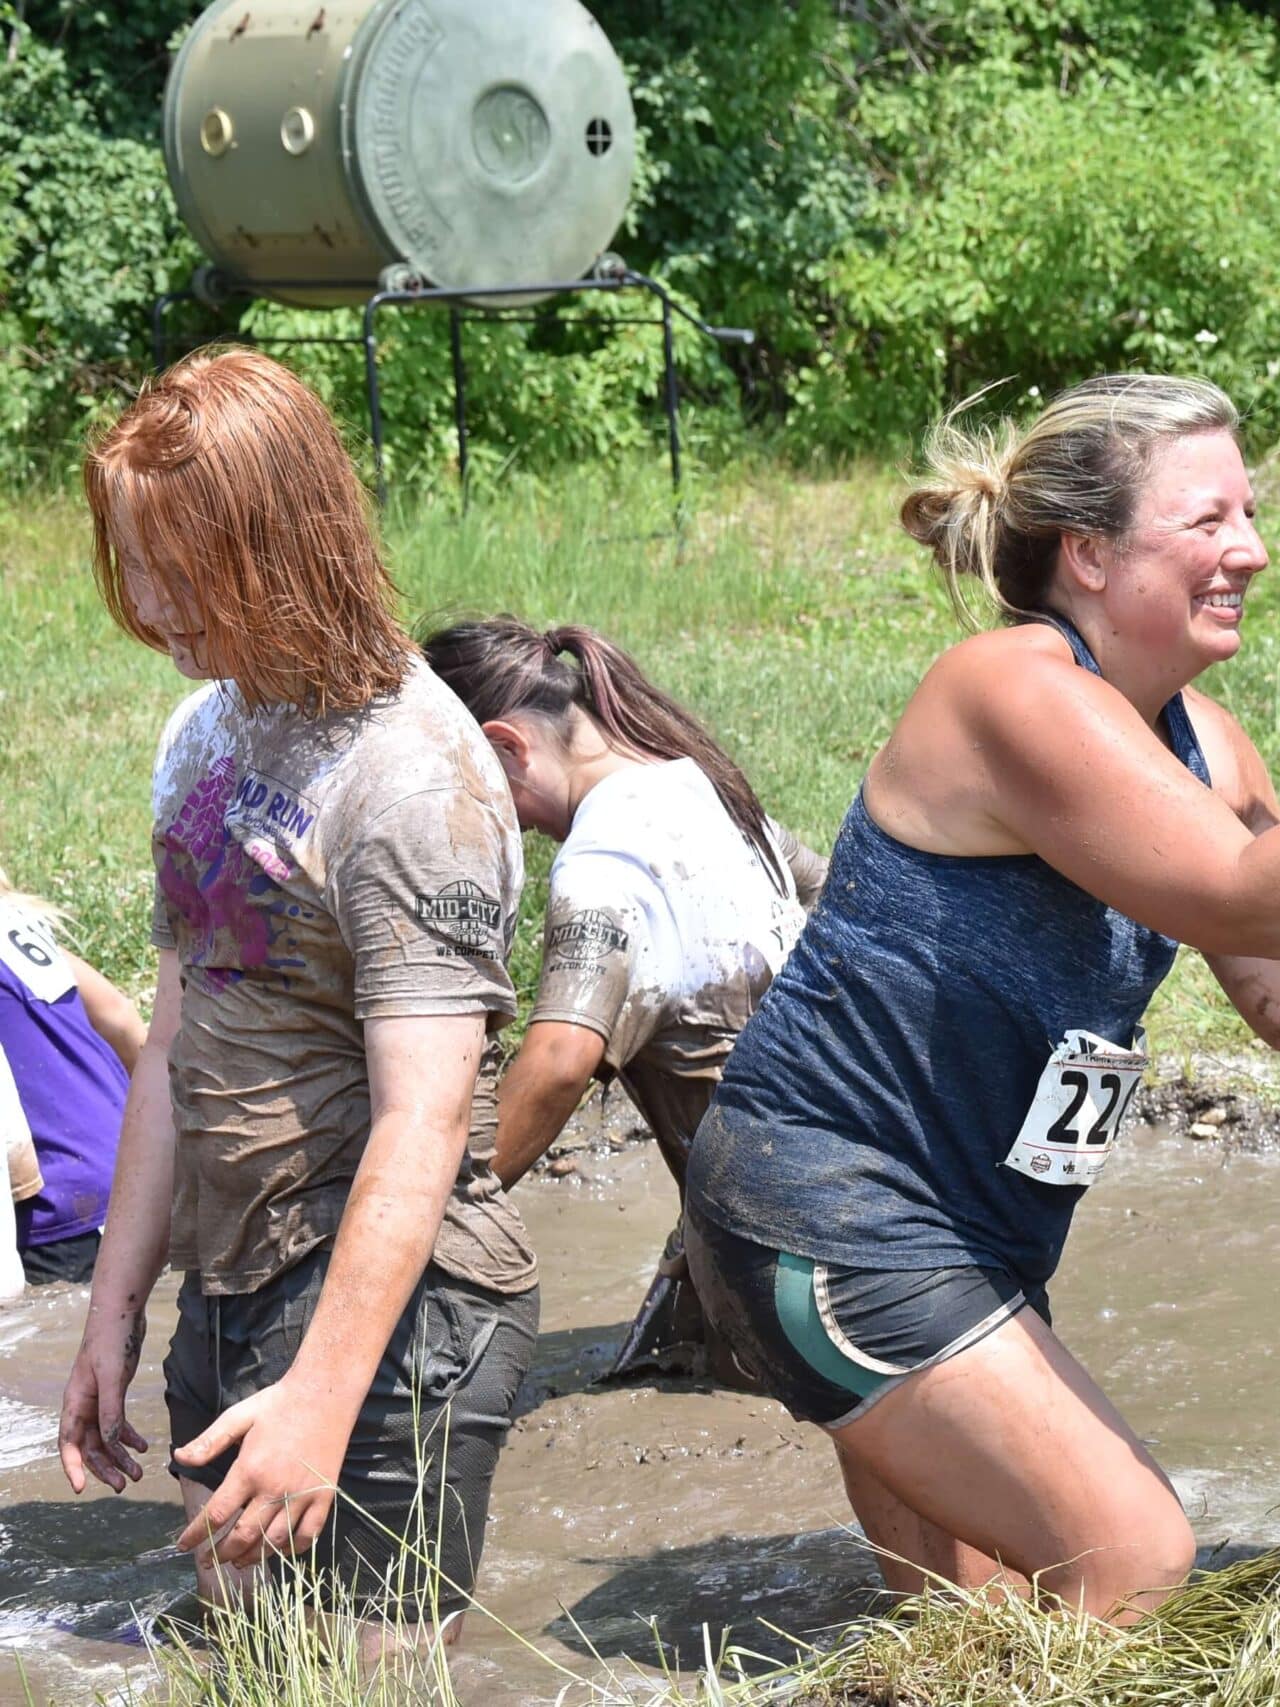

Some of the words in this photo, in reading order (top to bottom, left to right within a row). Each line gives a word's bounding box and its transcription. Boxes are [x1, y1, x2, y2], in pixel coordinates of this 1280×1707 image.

[267, 792, 314, 838] RUN
[419, 898, 500, 924] MID-CITY
[455, 945, 500, 960] COMPET
